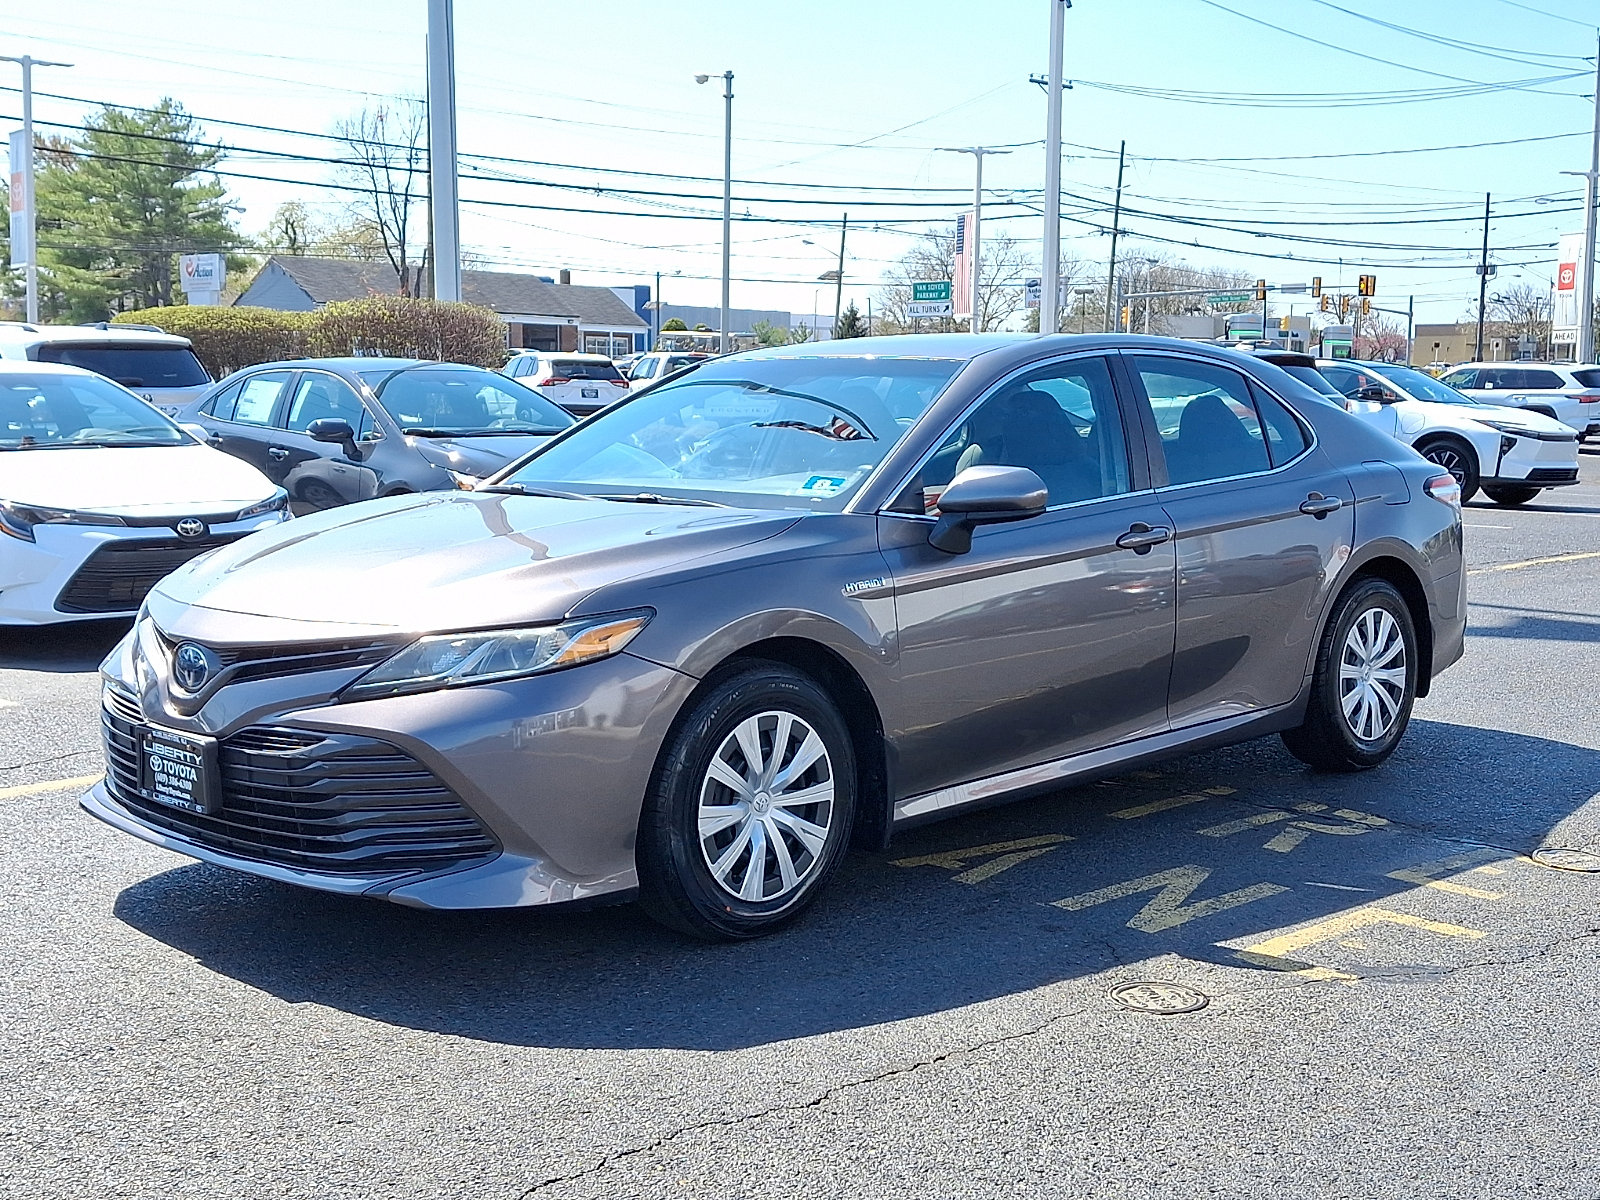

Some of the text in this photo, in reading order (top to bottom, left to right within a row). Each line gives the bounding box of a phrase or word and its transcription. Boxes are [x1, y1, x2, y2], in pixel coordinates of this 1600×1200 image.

[922, 305, 940, 313] TURNS
[1555, 332, 1575, 340] AHEAD
[844, 577, 886, 592] HYBRID
[143, 740, 202, 765] LIBERTY
[162, 759, 198, 782] TOYOTA
